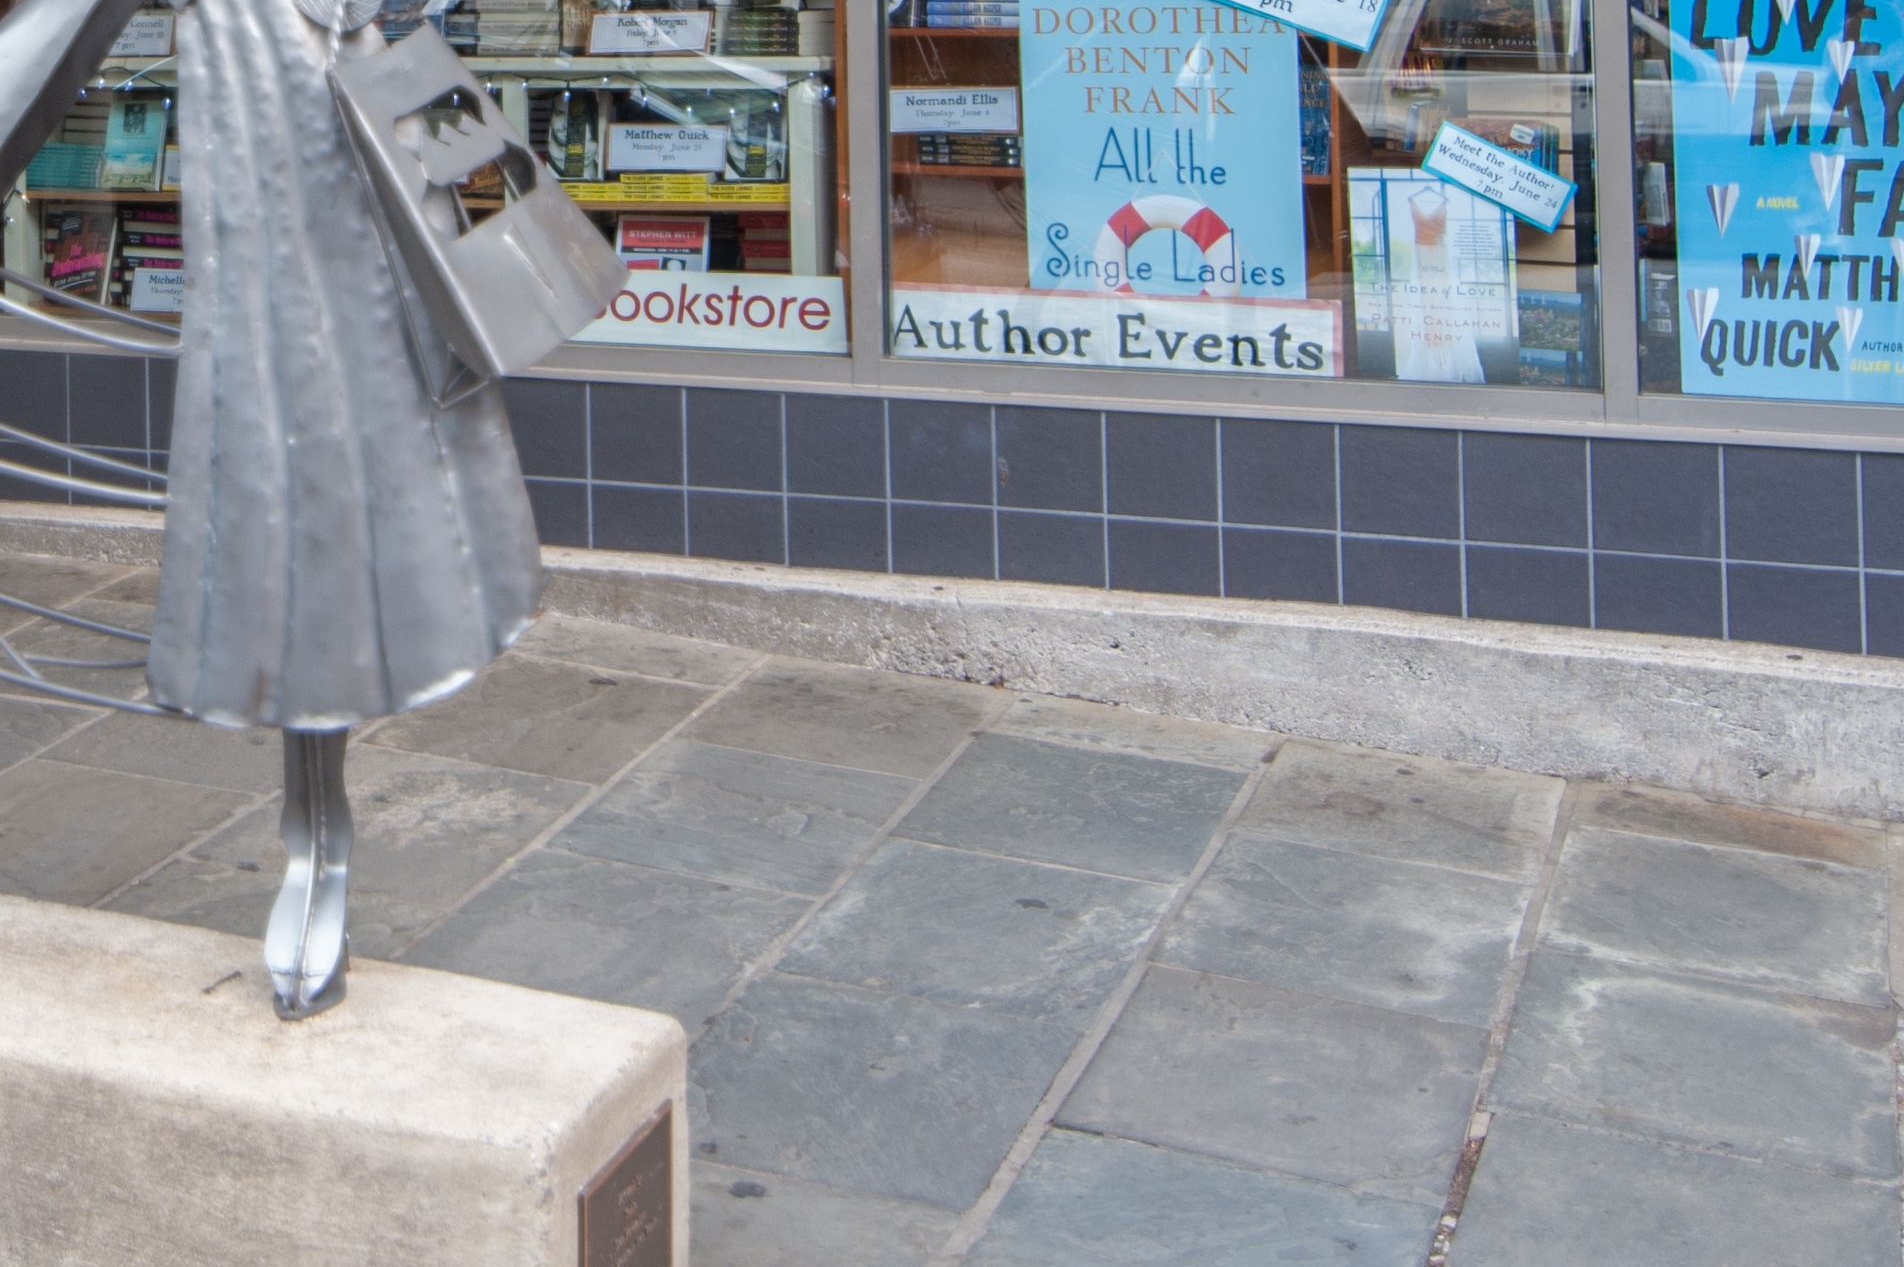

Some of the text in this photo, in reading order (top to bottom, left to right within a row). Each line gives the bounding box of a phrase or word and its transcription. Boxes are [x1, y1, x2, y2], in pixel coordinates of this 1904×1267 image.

[130, 18, 164, 29] Connell
[654, 17, 688, 29] Morgan
[1032, 6, 1287, 35] DOROTHEA
[1461, 37, 1539, 46] SCOTT GRAHAM
[1064, 46, 1253, 75] BENTON
[906, 94, 999, 107] Normandi Ellis
[1083, 86, 1237, 115] FRANK
[960, 109, 983, 118] June
[1749, 70, 1904, 148] MAY
[624, 129, 709, 141] Matthew Quick
[670, 143, 690, 152] June
[1094, 127, 1227, 185] All the
[1453, 135, 1556, 192] Meet the Author!
[1483, 184, 1504, 200] pm
[1511, 180, 1558, 209] June 24
[1756, 197, 1800, 209] A NOVEL
[629, 229, 697, 240] STEPHEN WITT
[1046, 222, 1286, 287] Single Ladies
[1371, 283, 1399, 293] THE
[1404, 283, 1438, 294] IDEA
[1457, 285, 1496, 297] LOVE
[595, 284, 831, 331] ookstore
[1371, 313, 1501, 329] PATTI CALLAHAN
[894, 304, 1325, 371] Author Events
[1411, 330, 1463, 342] HENRY
[1700, 318, 1841, 377] QUICK
[1861, 340, 1903, 353] AUTHOR
[1850, 359, 1892, 372] SILVER
